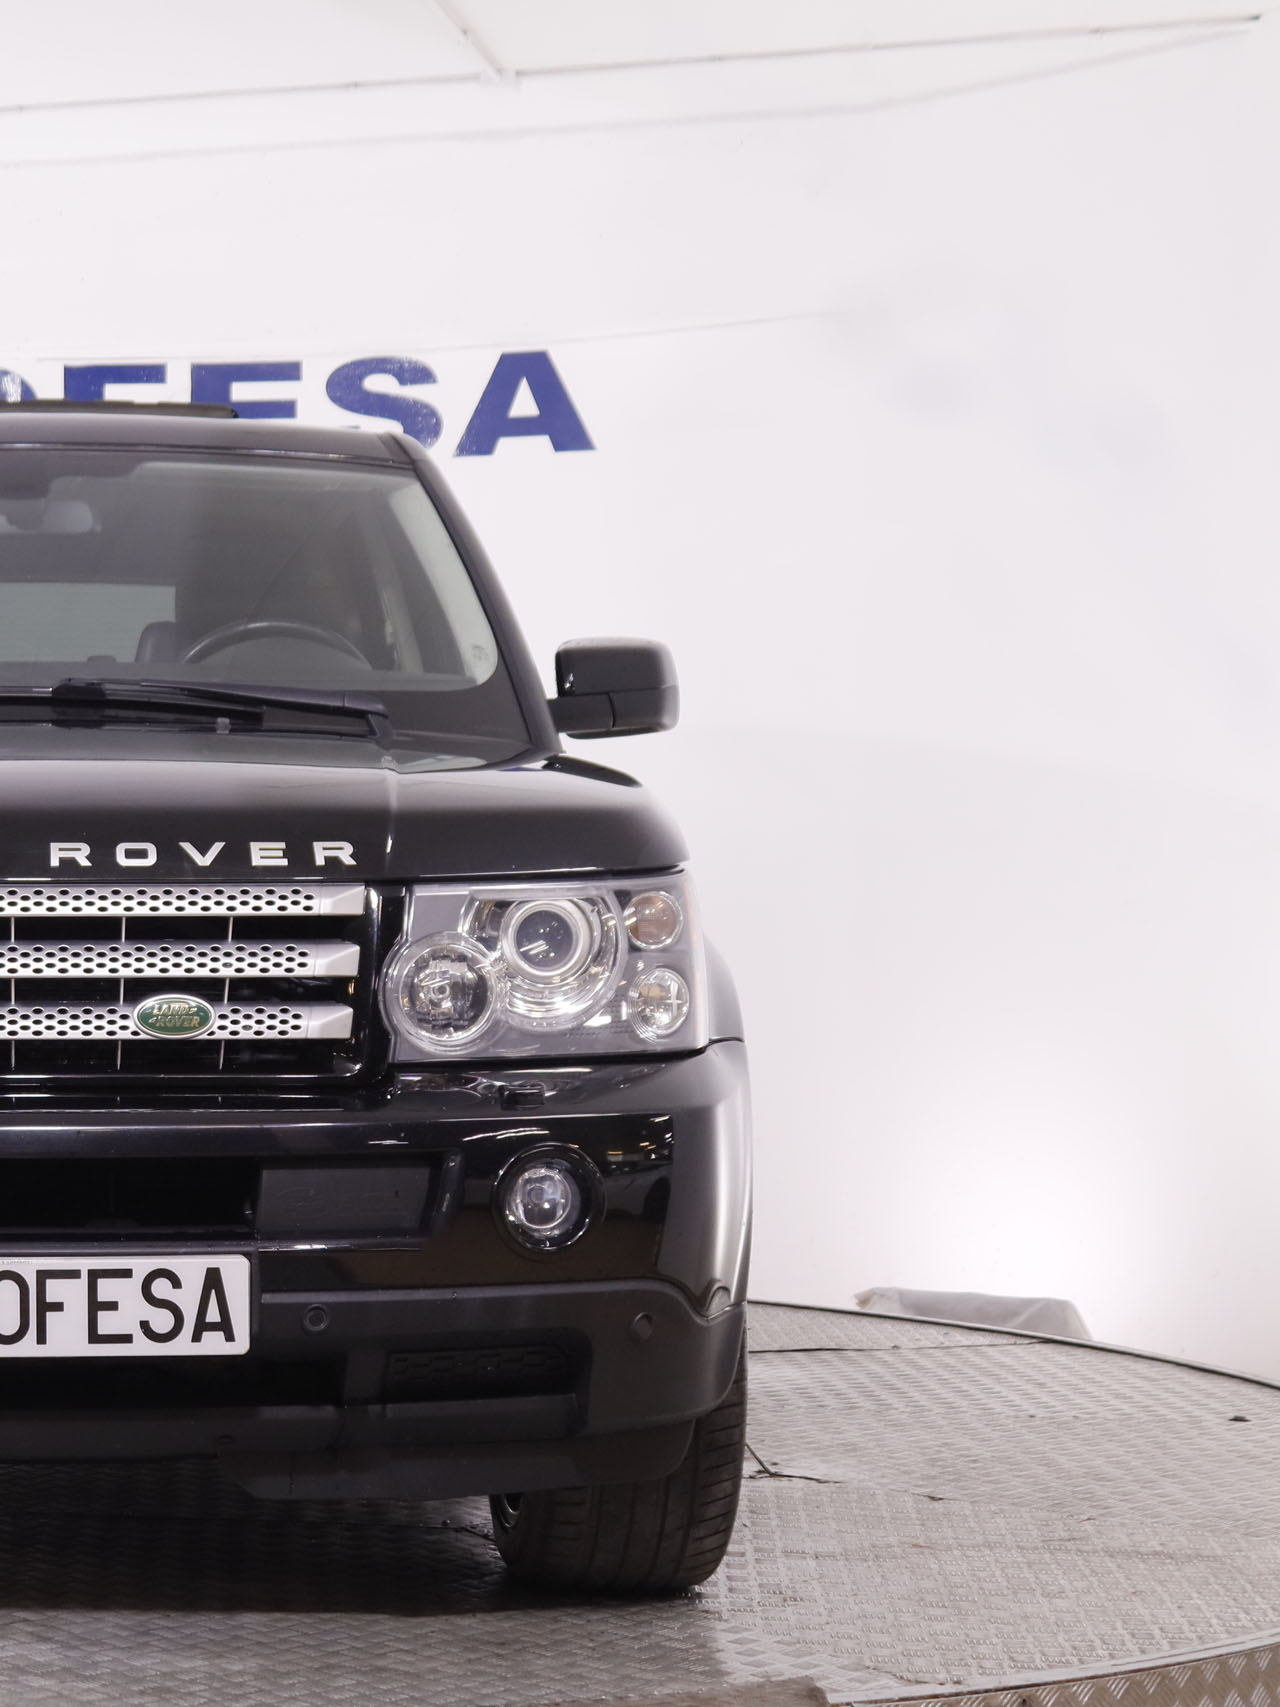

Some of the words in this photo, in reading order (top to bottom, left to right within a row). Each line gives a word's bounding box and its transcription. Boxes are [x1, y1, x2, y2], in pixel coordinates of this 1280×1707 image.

[49, 841, 358, 868] ROVER
[153, 1003, 190, 1015] LAND
[156, 1015, 200, 1027] ROVER
